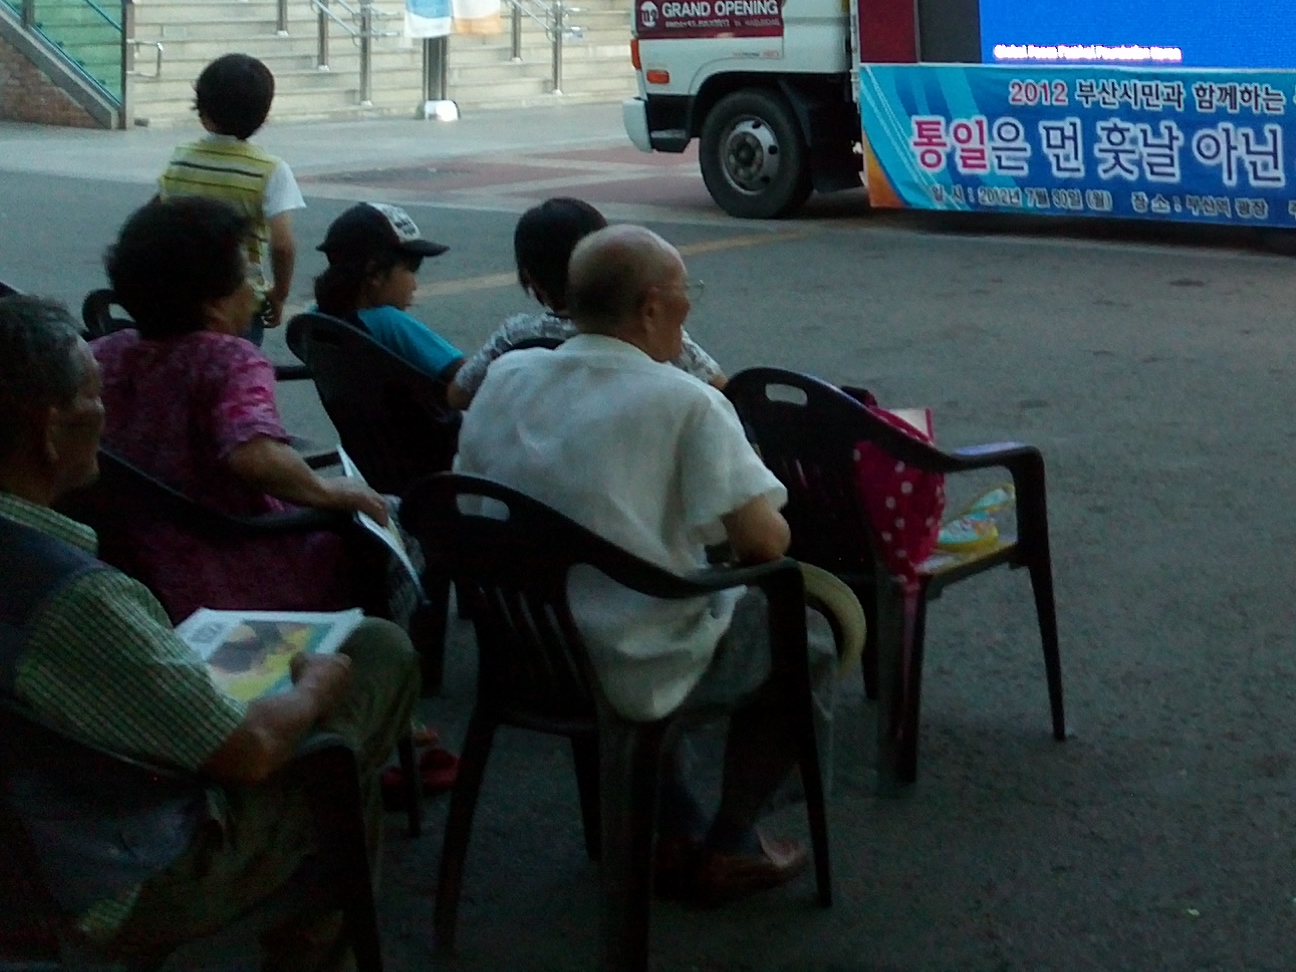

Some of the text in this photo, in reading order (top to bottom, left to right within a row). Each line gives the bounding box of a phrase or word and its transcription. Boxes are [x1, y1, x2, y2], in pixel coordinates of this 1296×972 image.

[662, 0, 778, 18] GRAND OPENING
[1010, 81, 1068, 105] 2012
[1077, 81, 1184, 109] 부산시민과
[1193, 82, 1285, 113] 함께하는
[912, 116, 1029, 176] 통일은
[1043, 117, 1085, 177] 먼
[1097, 121, 1181, 182] 훗날
[1195, 123, 1284, 186] 아닌
